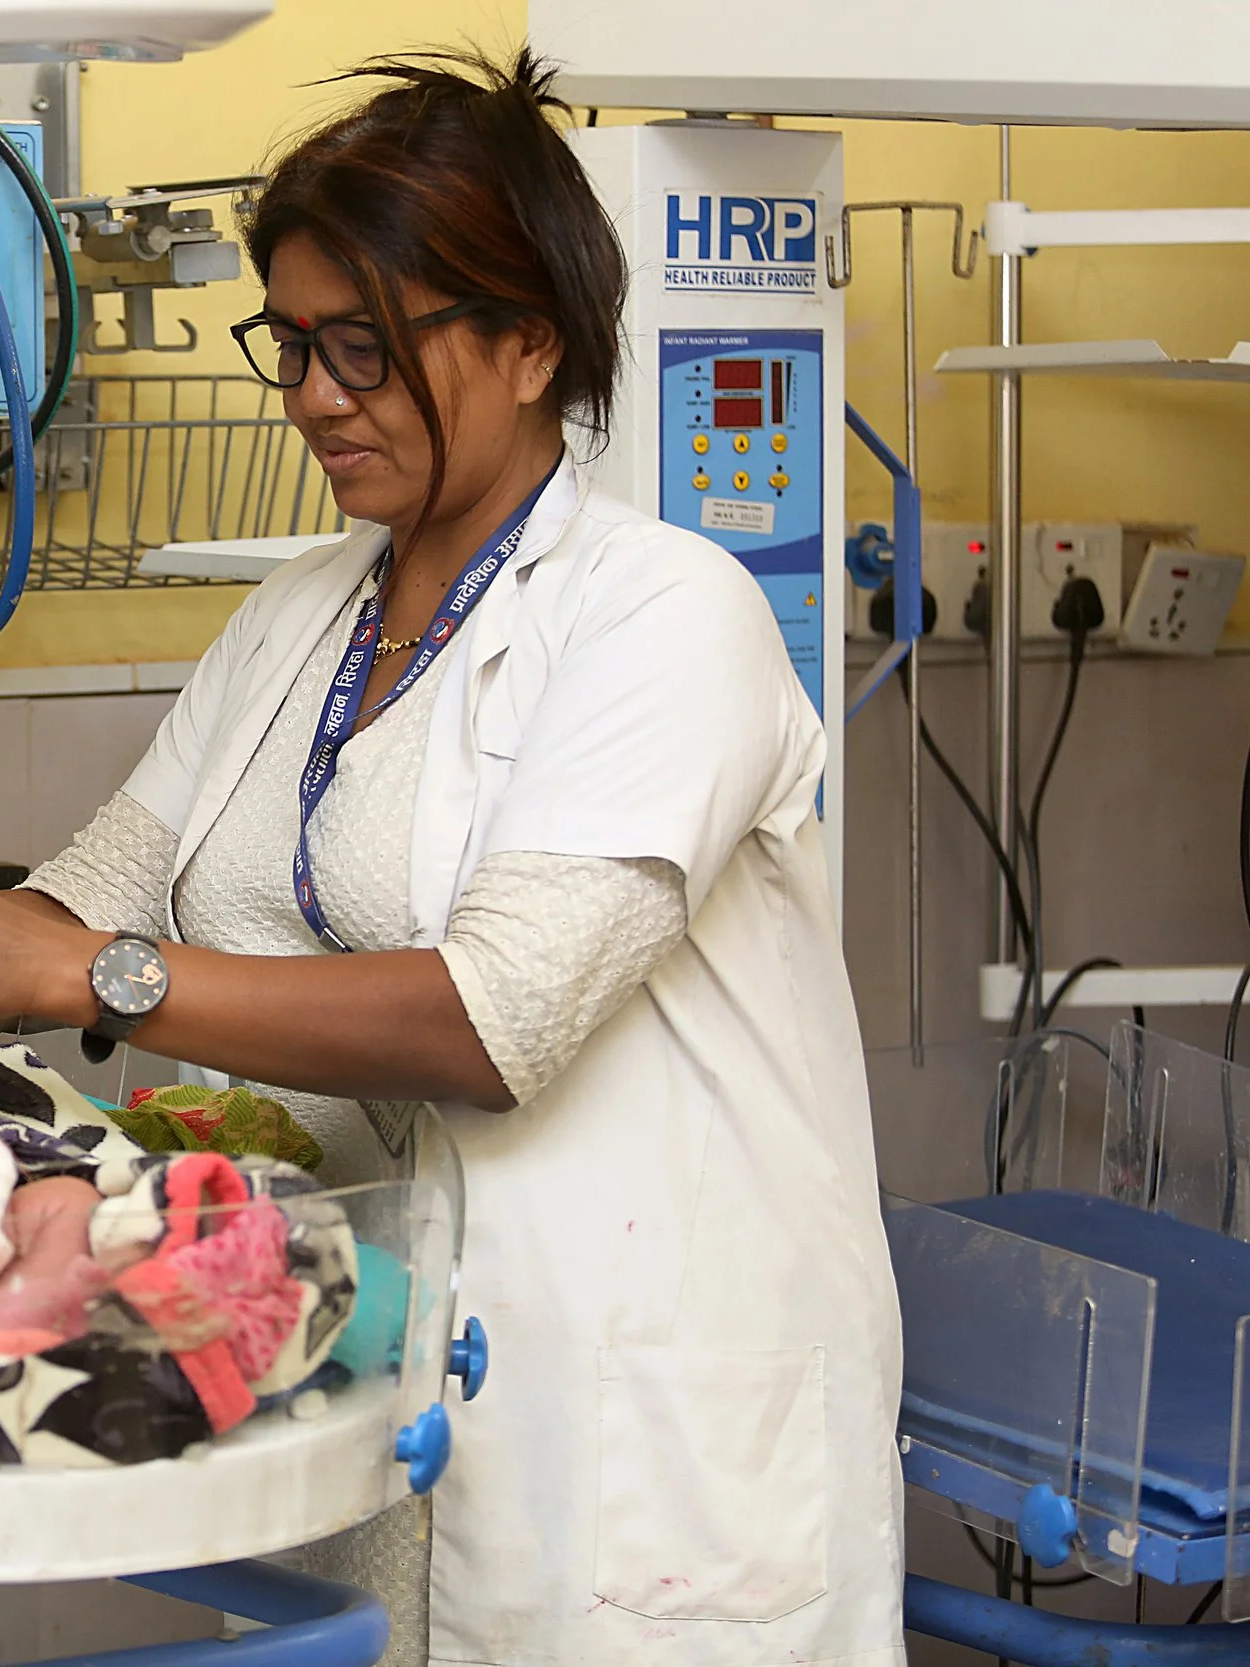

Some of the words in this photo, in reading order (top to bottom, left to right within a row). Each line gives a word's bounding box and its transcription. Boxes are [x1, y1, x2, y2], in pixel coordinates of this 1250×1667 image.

[667, 195, 815, 262] HRP
[665, 270, 708, 285] HEALTH
[712, 271, 764, 286] RELIABLE
[767, 273, 816, 288] PRODUCT
[664, 337, 687, 345] INFANT
[689, 337, 717, 345] RADIANT
[719, 337, 749, 345] WARMER
[449, 555, 498, 613] प्रादेशिक
[335, 651, 364, 688] सिरहा
